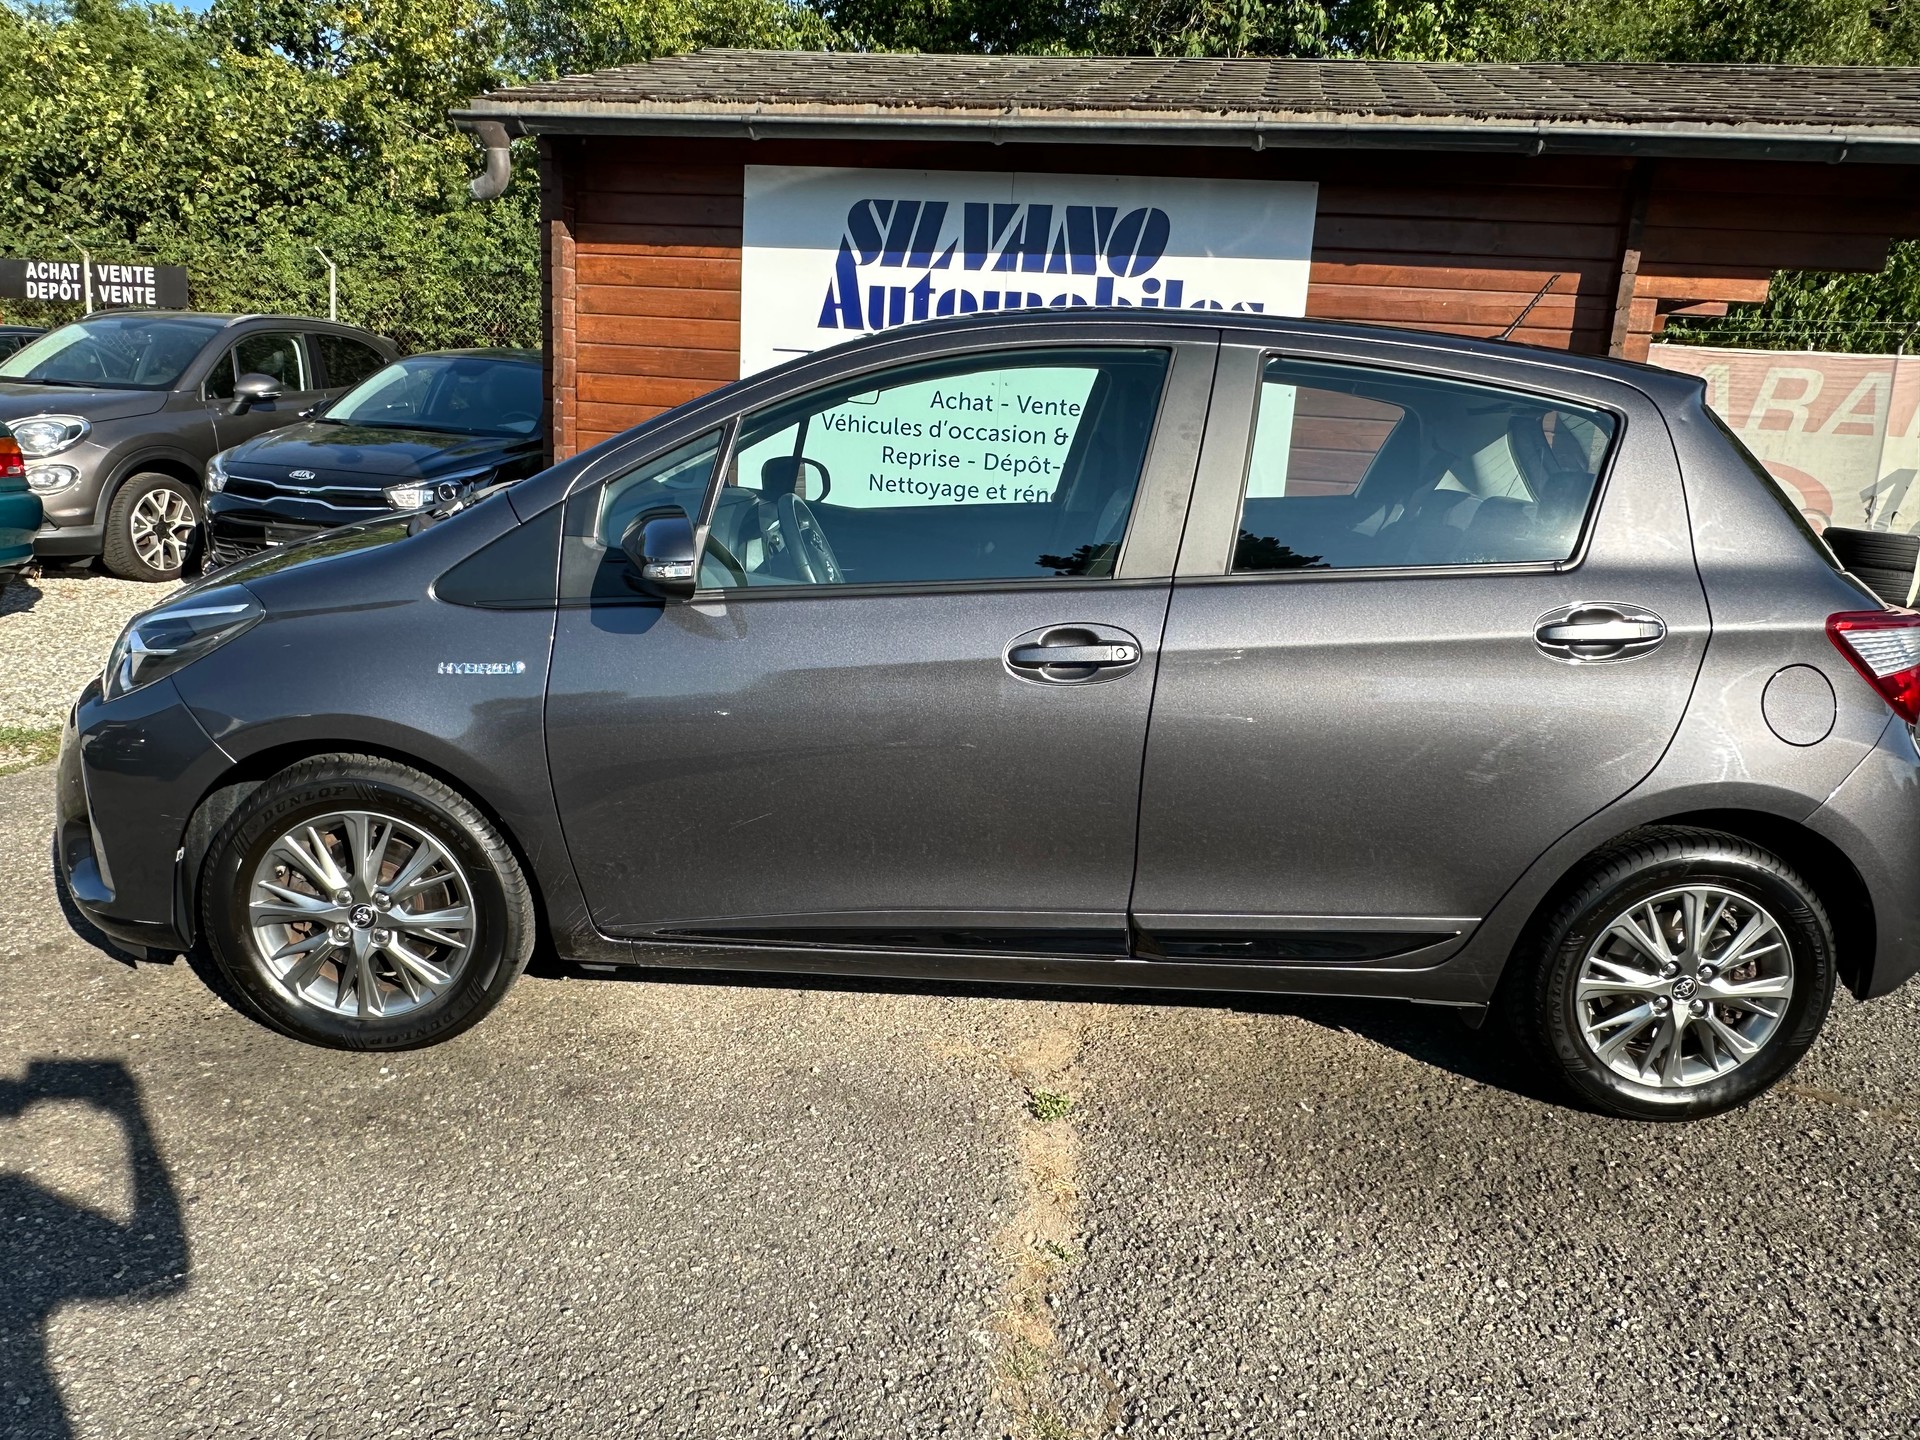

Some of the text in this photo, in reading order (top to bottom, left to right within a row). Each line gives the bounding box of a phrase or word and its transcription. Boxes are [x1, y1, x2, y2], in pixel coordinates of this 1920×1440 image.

[847, 199, 1170, 278] SILVANO
[26, 262, 155, 285] ACHAT VENTE
[26, 280, 157, 305] DEPÔT VENTE
[930, 390, 994, 413] Achat
[1017, 394, 1081, 417] Vente
[821, 412, 1070, 446] Véhicules d'occasion &
[882, 446, 960, 470] Reprise
[984, 452, 1065, 477] Dépôt-
[869, 473, 1057, 503] Nettoyage et rén
[438, 661, 514, 675] HYBRID
[262, 786, 347, 823] DUNLOP
